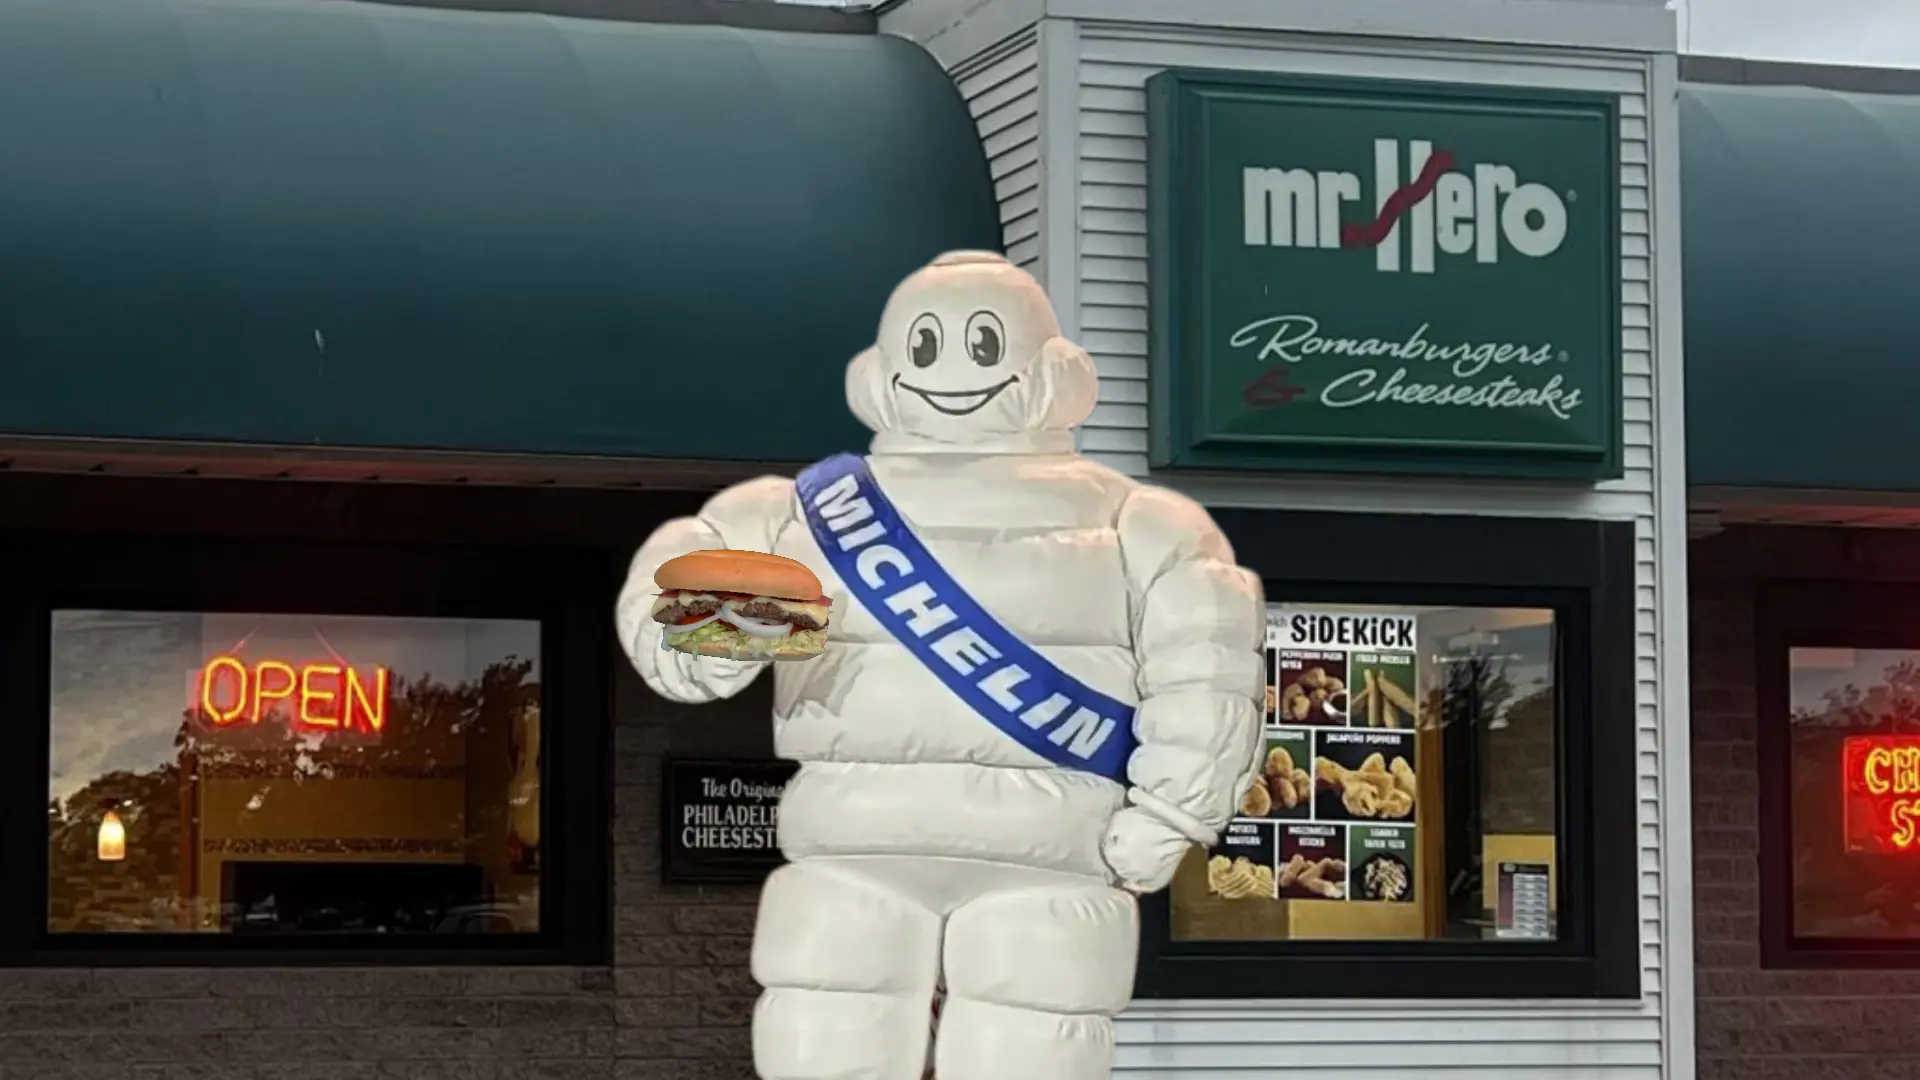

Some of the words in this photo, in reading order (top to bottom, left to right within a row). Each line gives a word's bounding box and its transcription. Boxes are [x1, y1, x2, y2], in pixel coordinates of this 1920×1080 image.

[1230, 314, 1551, 378] Romanburgers
[1320, 366, 1582, 420] Cheesesteaks
[814, 473, 1117, 760] MICHELIN
[203, 656, 389, 730] OPEN
[701, 778, 727, 797] The
